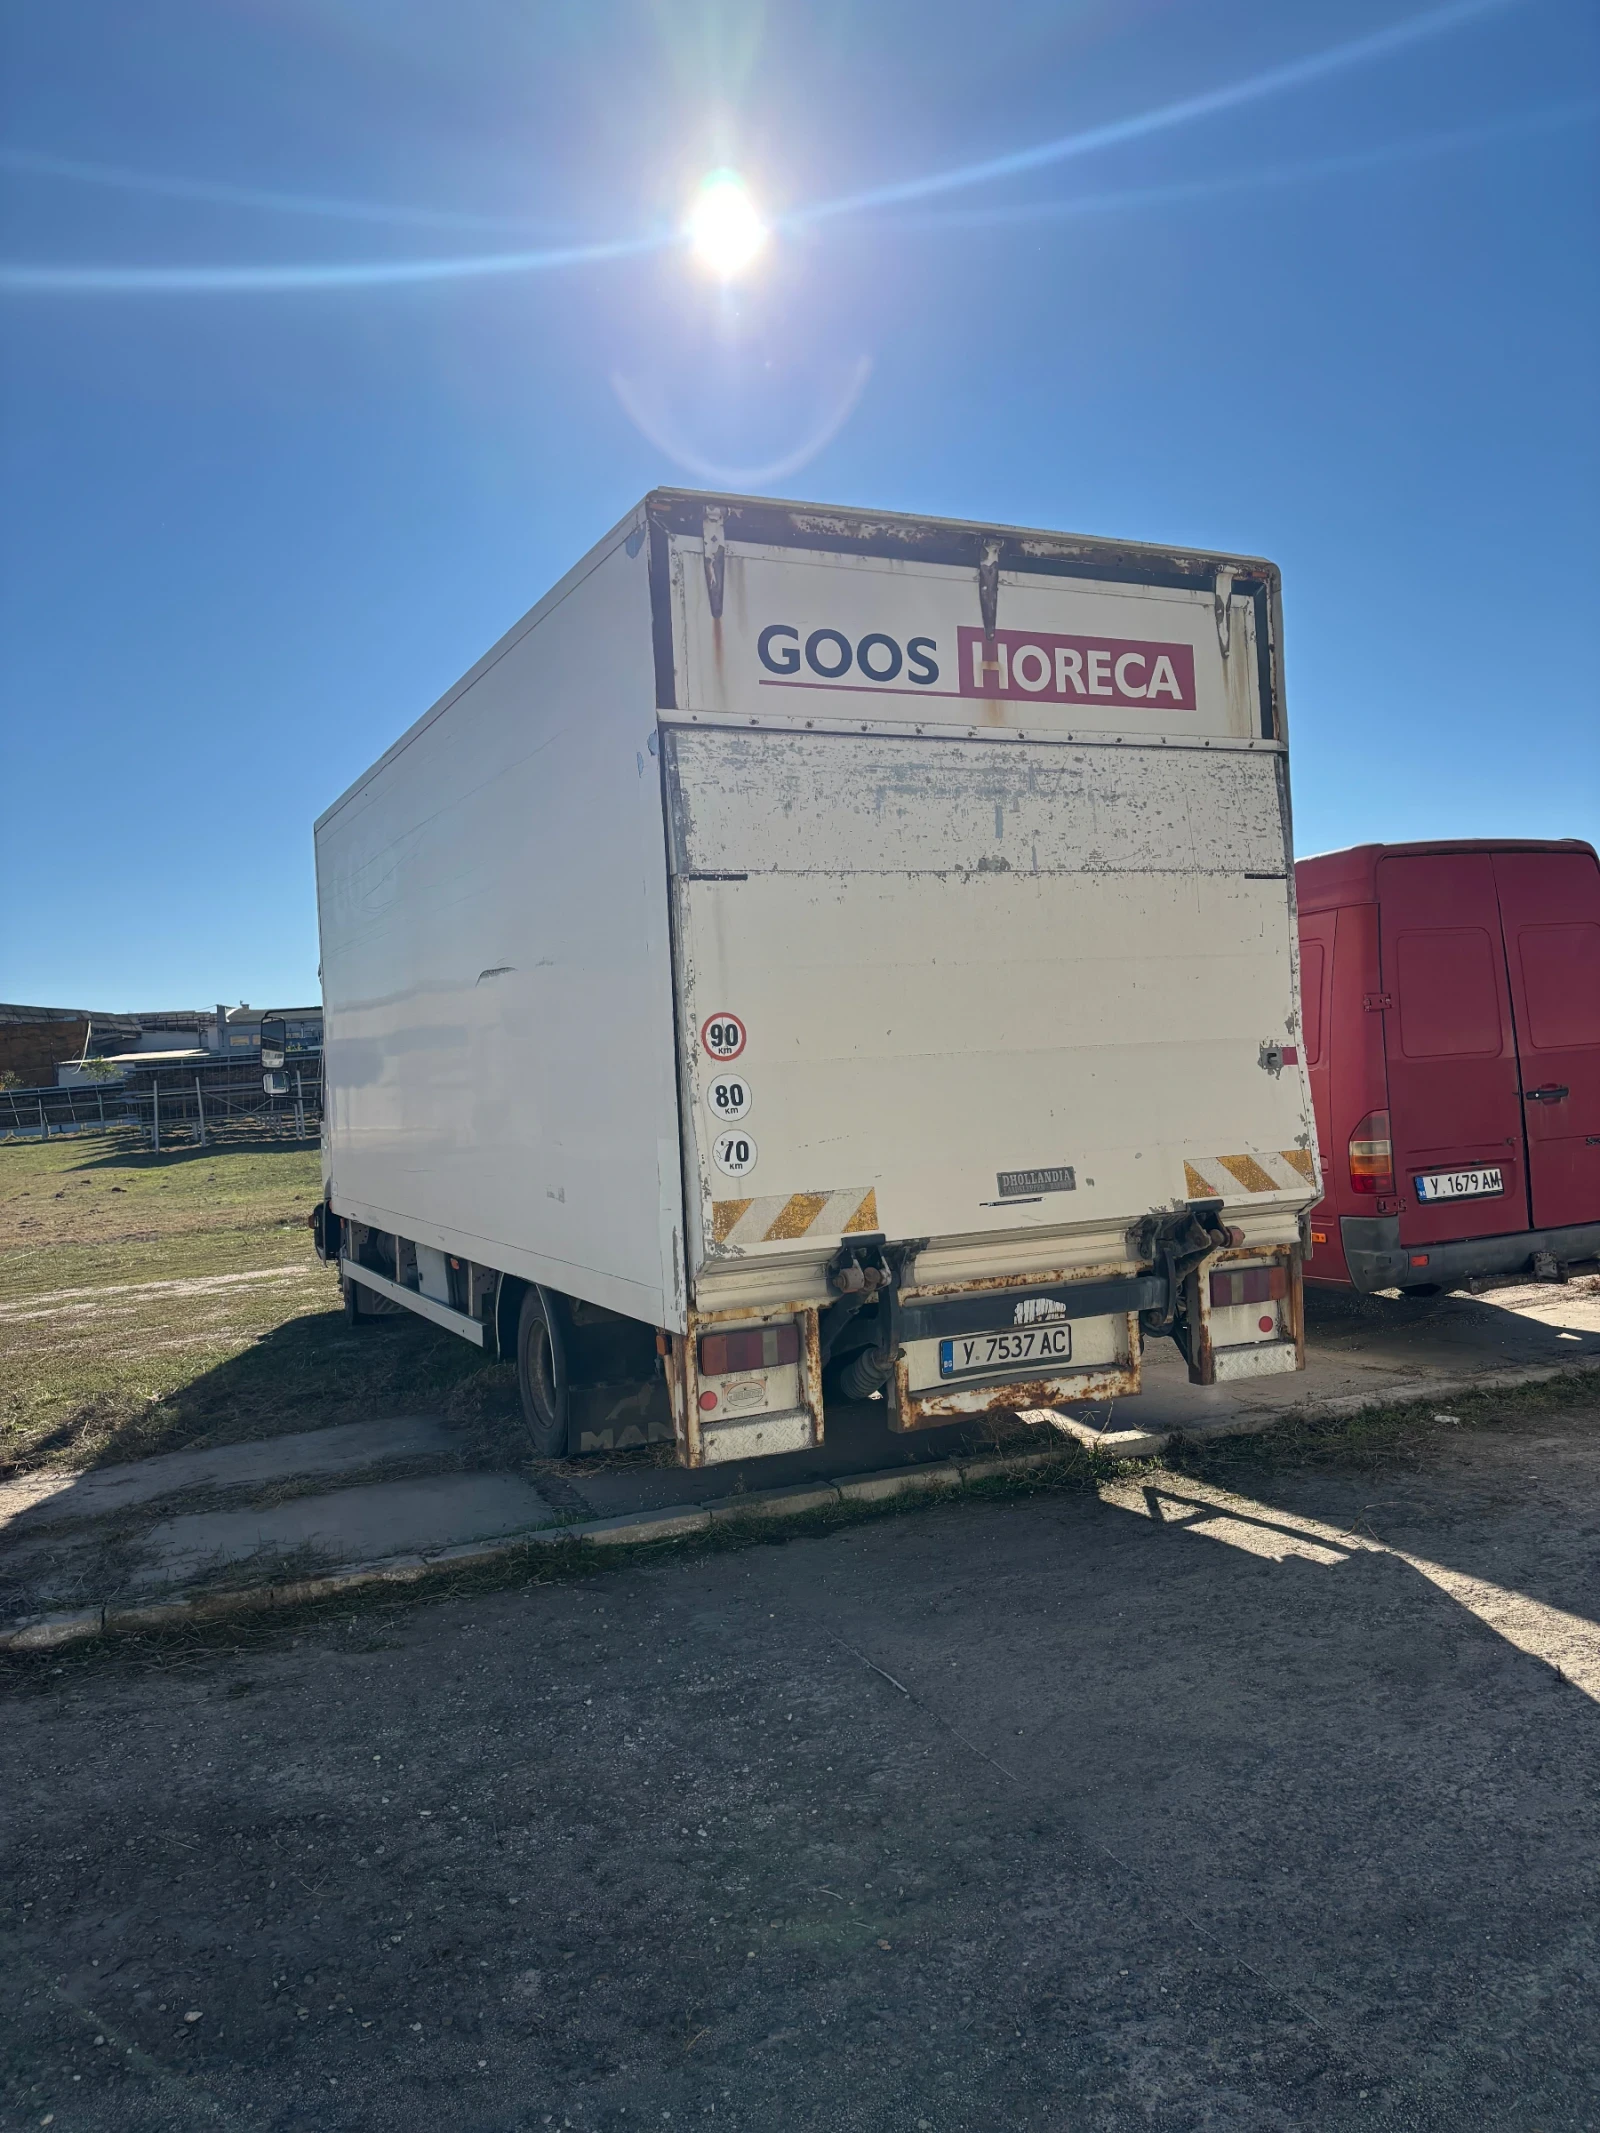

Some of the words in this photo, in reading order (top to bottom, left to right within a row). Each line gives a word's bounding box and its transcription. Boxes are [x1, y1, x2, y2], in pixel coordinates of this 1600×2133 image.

[757, 624, 940, 685] GOOS
[971, 640, 1184, 700] HORECA
[710, 1024, 739, 1047] 90
[715, 1084, 744, 1107] 80
[720, 1140, 749, 1162] 70
[1002, 1170, 1071, 1187] DHOLLANDIA
[1447, 1174, 1479, 1193] 1679
[1482, 1171, 1500, 1190] AM
[986, 1333, 1035, 1361] 7537
[1040, 1330, 1066, 1355] AC
[580, 1421, 676, 1452] MAN
